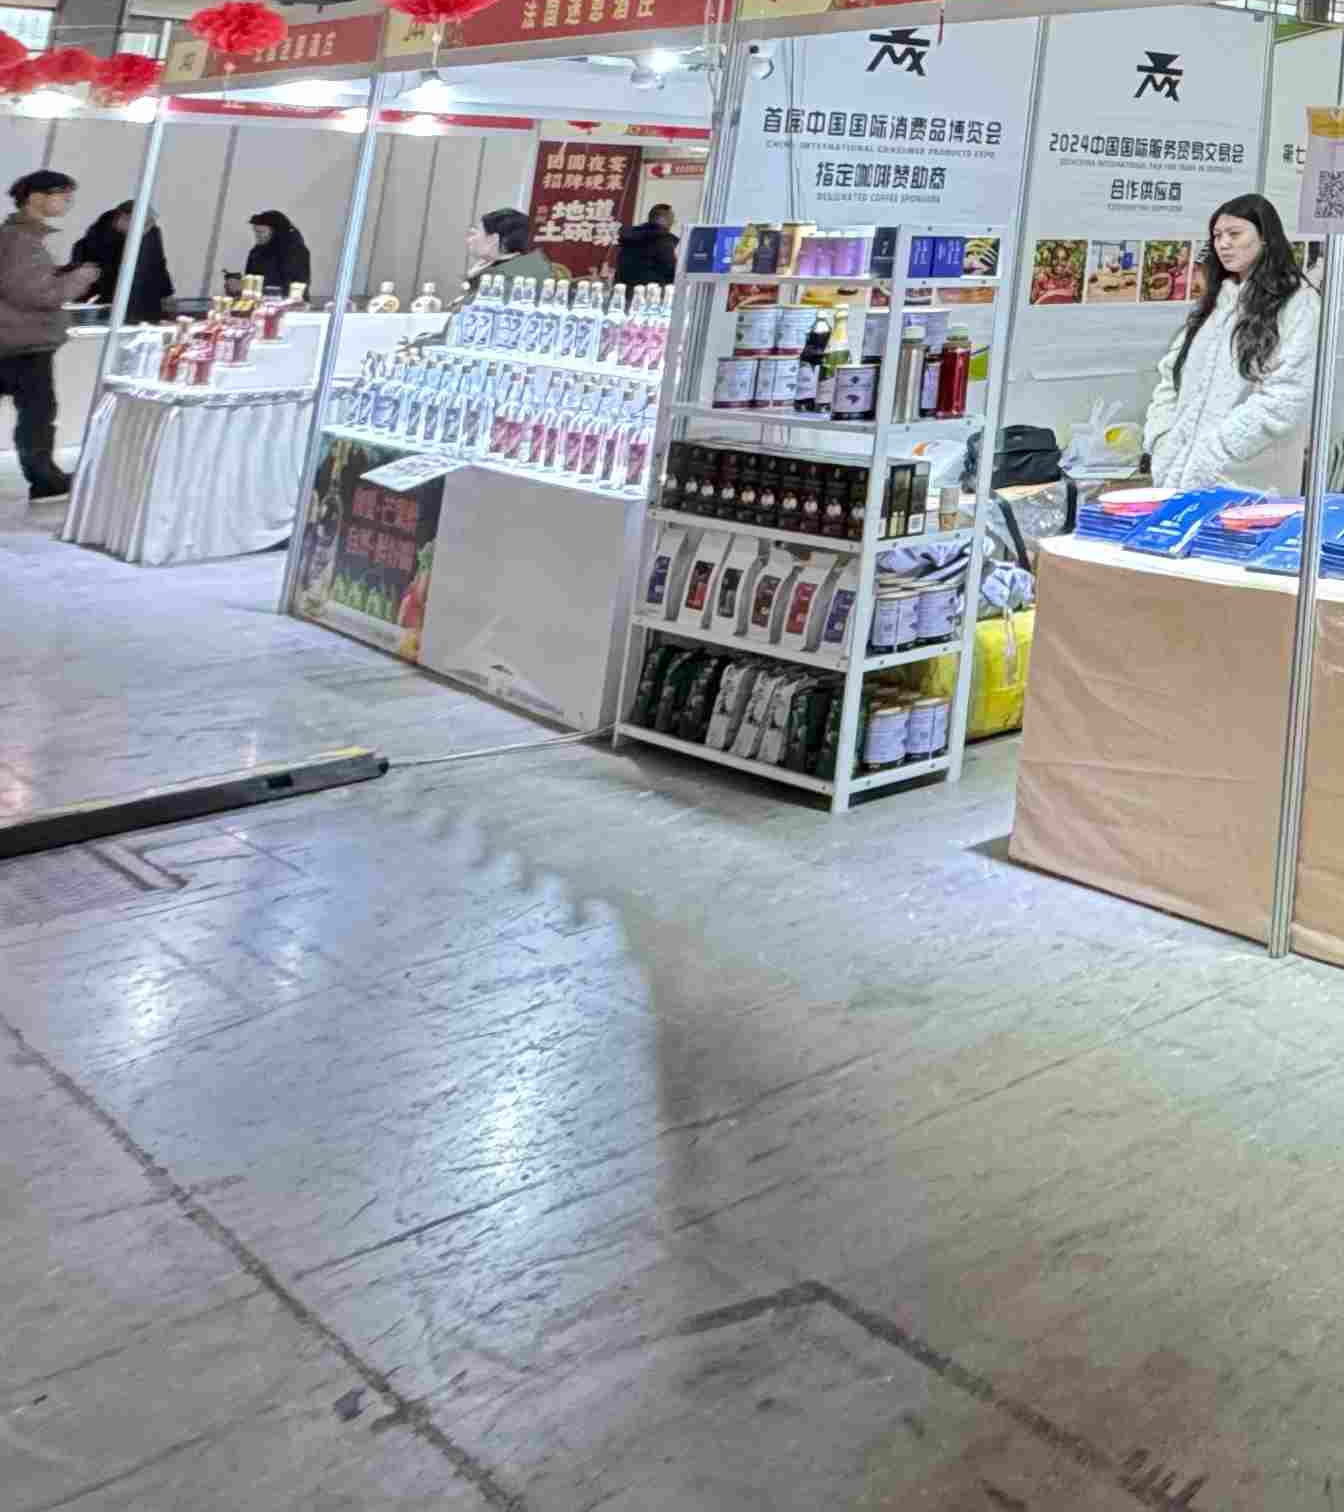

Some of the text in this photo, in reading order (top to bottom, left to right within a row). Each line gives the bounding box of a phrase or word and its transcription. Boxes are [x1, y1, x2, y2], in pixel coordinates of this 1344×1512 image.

[763, 105, 1001, 145] 首届中国国际消费品博览会
[815, 161, 947, 190] 指定咖啡赞助商
